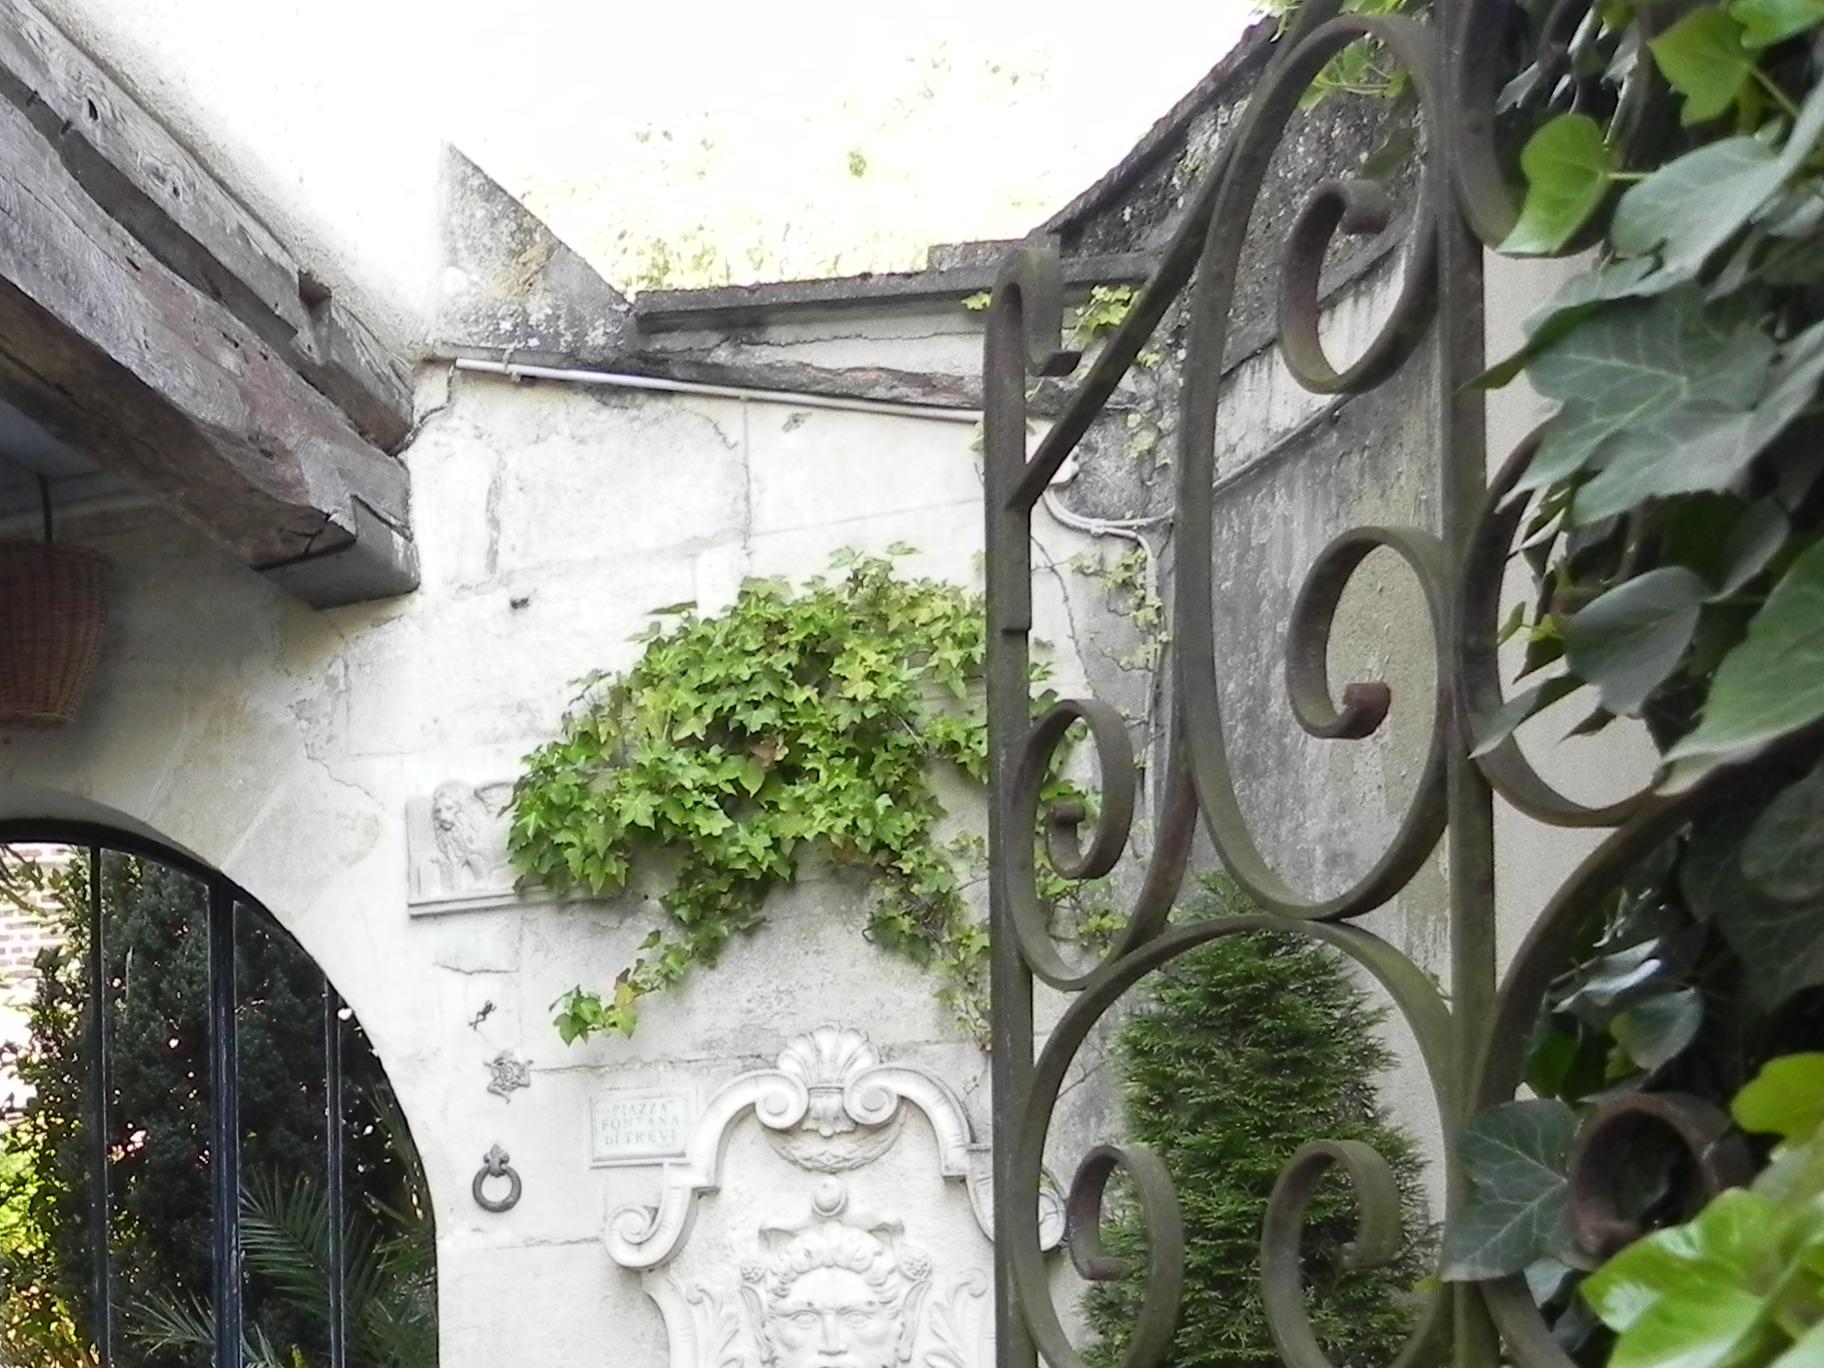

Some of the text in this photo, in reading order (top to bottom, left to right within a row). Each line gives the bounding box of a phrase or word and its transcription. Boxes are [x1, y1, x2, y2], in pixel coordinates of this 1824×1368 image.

[612, 1102, 668, 1117] PIAZZA
[601, 1115, 680, 1131] FONTANA
[624, 1129, 678, 1145] TREVI
